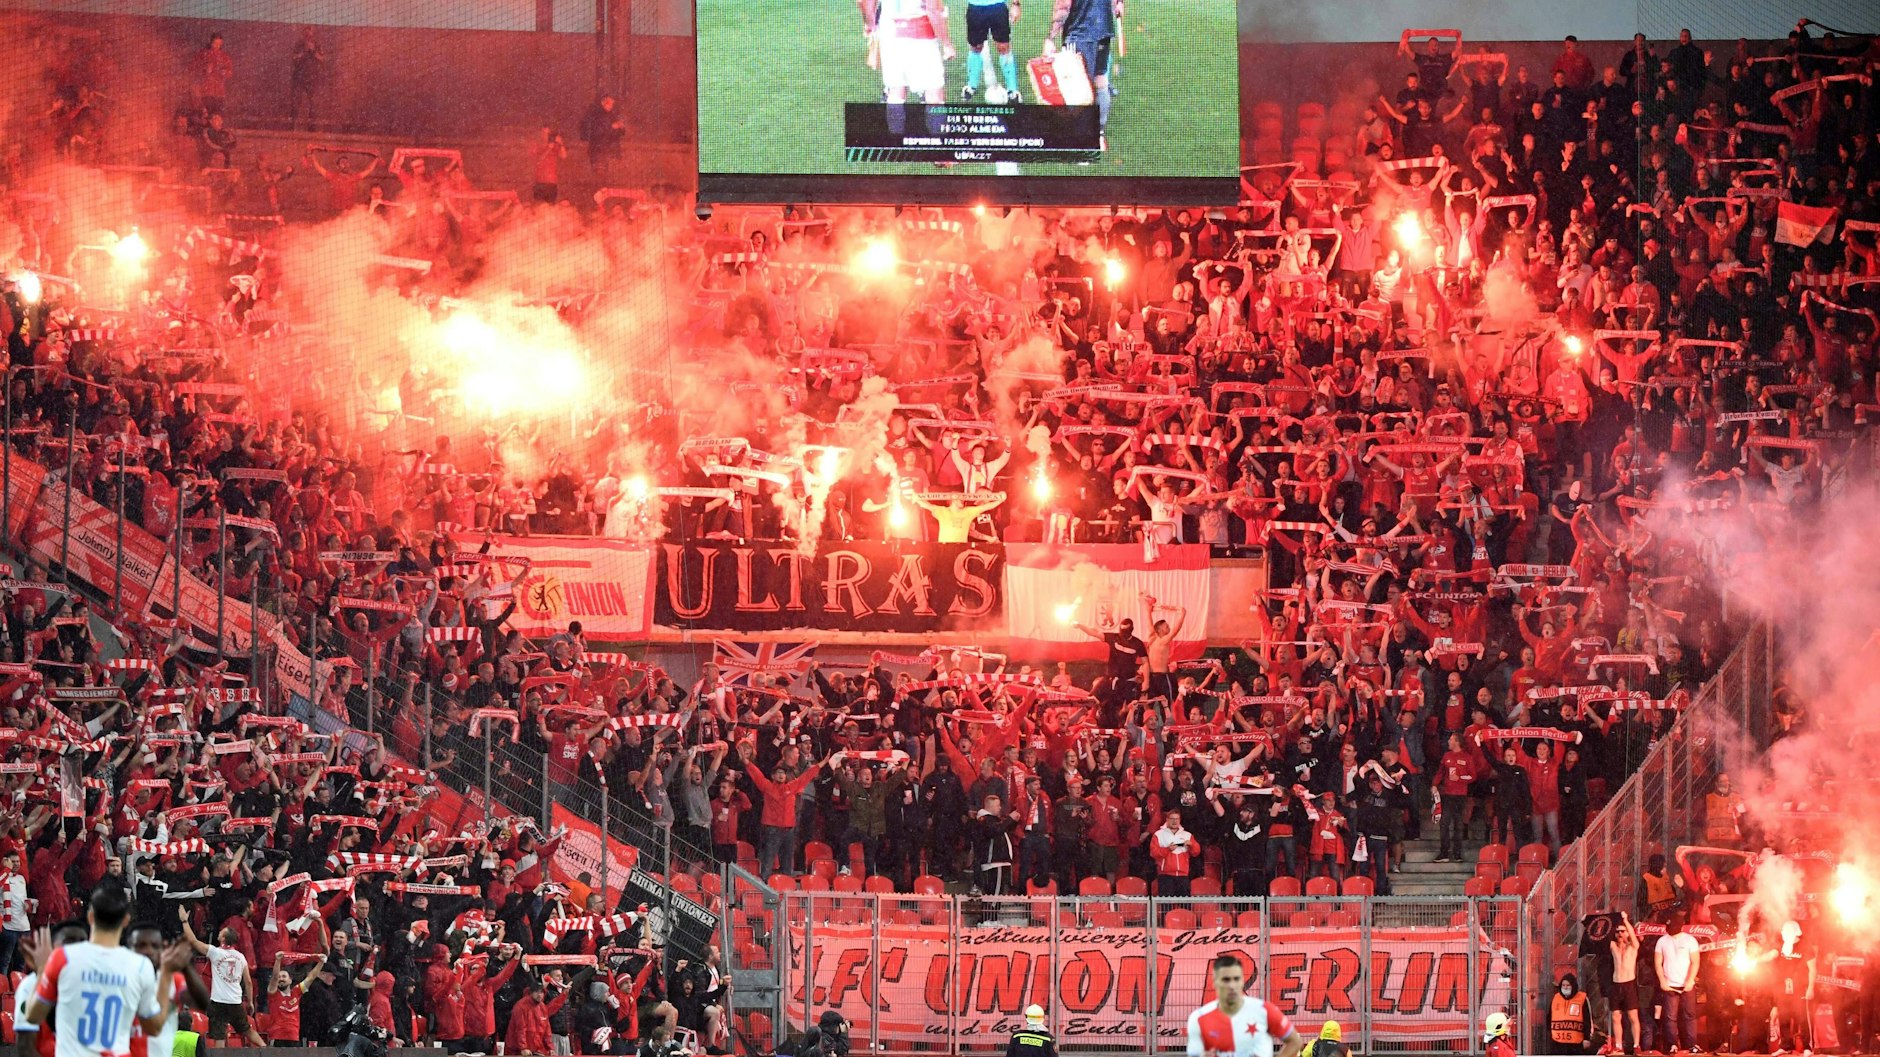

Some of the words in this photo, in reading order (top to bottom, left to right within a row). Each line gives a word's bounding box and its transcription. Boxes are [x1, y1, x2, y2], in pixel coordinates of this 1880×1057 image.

[695, 438, 731, 447] BERLIN
[78, 531, 116, 559] Johnny
[341, 552, 375, 560] BERLIN
[1505, 565, 1528, 576] UNION
[1543, 565, 1568, 577] BERLIN
[101, 575, 114, 590] on
[662, 543, 998, 620] ULTRAS
[563, 582, 628, 616] UNION
[1435, 592, 1479, 600] UNION
[1246, 695, 1274, 703] UNION
[1536, 687, 1559, 698] UNION
[1498, 729, 1510, 737] FC
[1512, 728, 1540, 737] Union
[1542, 729, 1568, 740] Berlin
[630, 872, 666, 900] EINMA
[670, 891, 716, 928] UNIONER
[1688, 924, 1716, 937] Union
[1171, 928, 1261, 952] Jahre
[924, 948, 1175, 1016] UNION
[77, 991, 123, 1050] 30
[1064, 1018, 1138, 1036] Ende
[1555, 1032, 1572, 1041] 315
